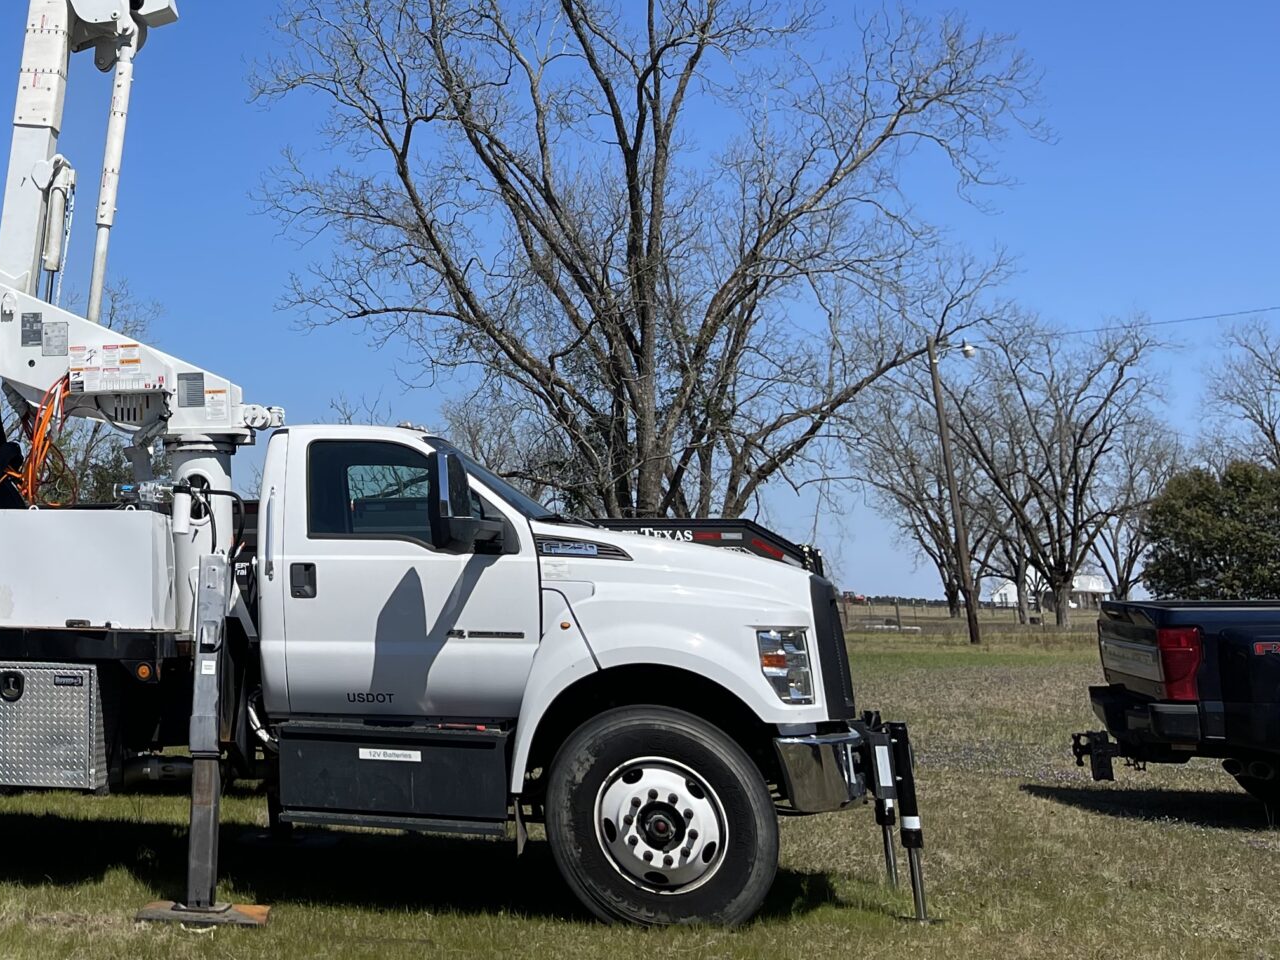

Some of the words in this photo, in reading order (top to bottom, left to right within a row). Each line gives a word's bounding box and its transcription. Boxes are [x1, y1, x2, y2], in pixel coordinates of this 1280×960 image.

[347, 693, 394, 703] USDOT
[368, 750, 381, 758] 12V
[382, 751, 412, 759] Batteries
